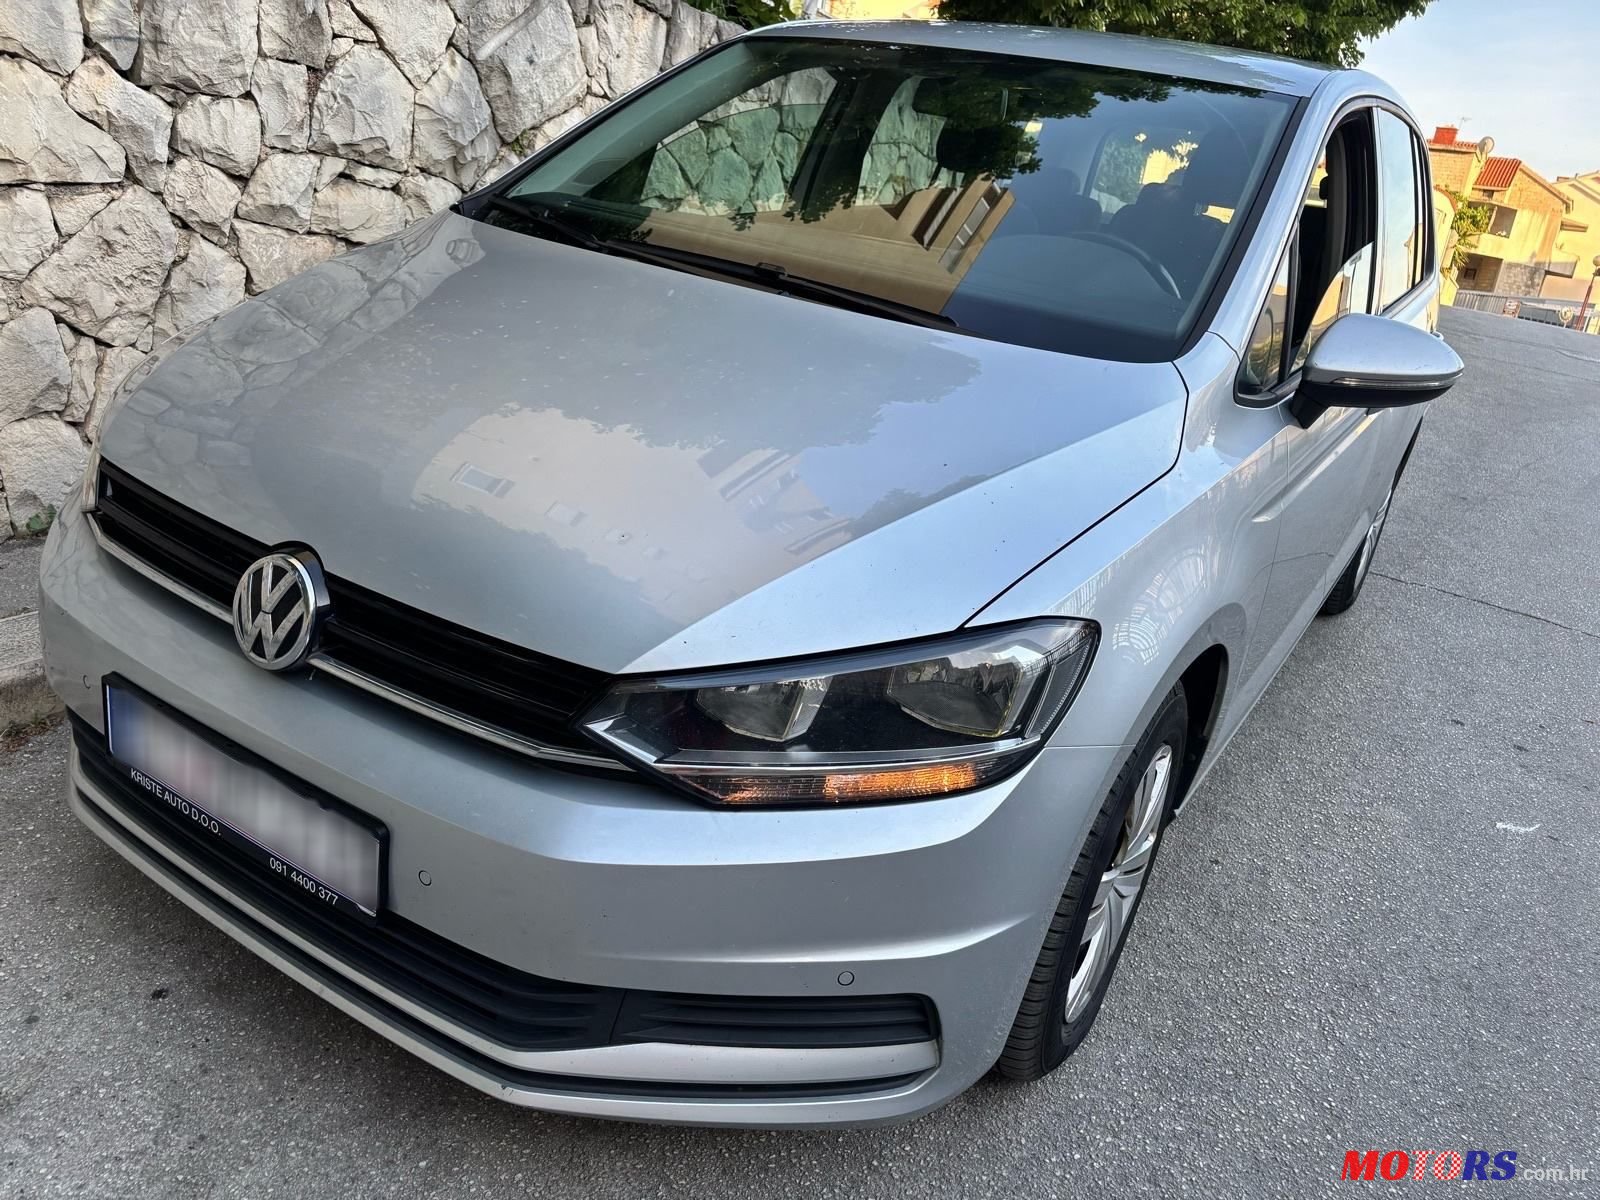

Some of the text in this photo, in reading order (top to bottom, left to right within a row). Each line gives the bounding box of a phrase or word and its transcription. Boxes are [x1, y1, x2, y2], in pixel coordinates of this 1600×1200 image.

[130, 767, 222, 836] KRISTE AUTO D.O.O.
[269, 857, 339, 905] 091 4400 377
